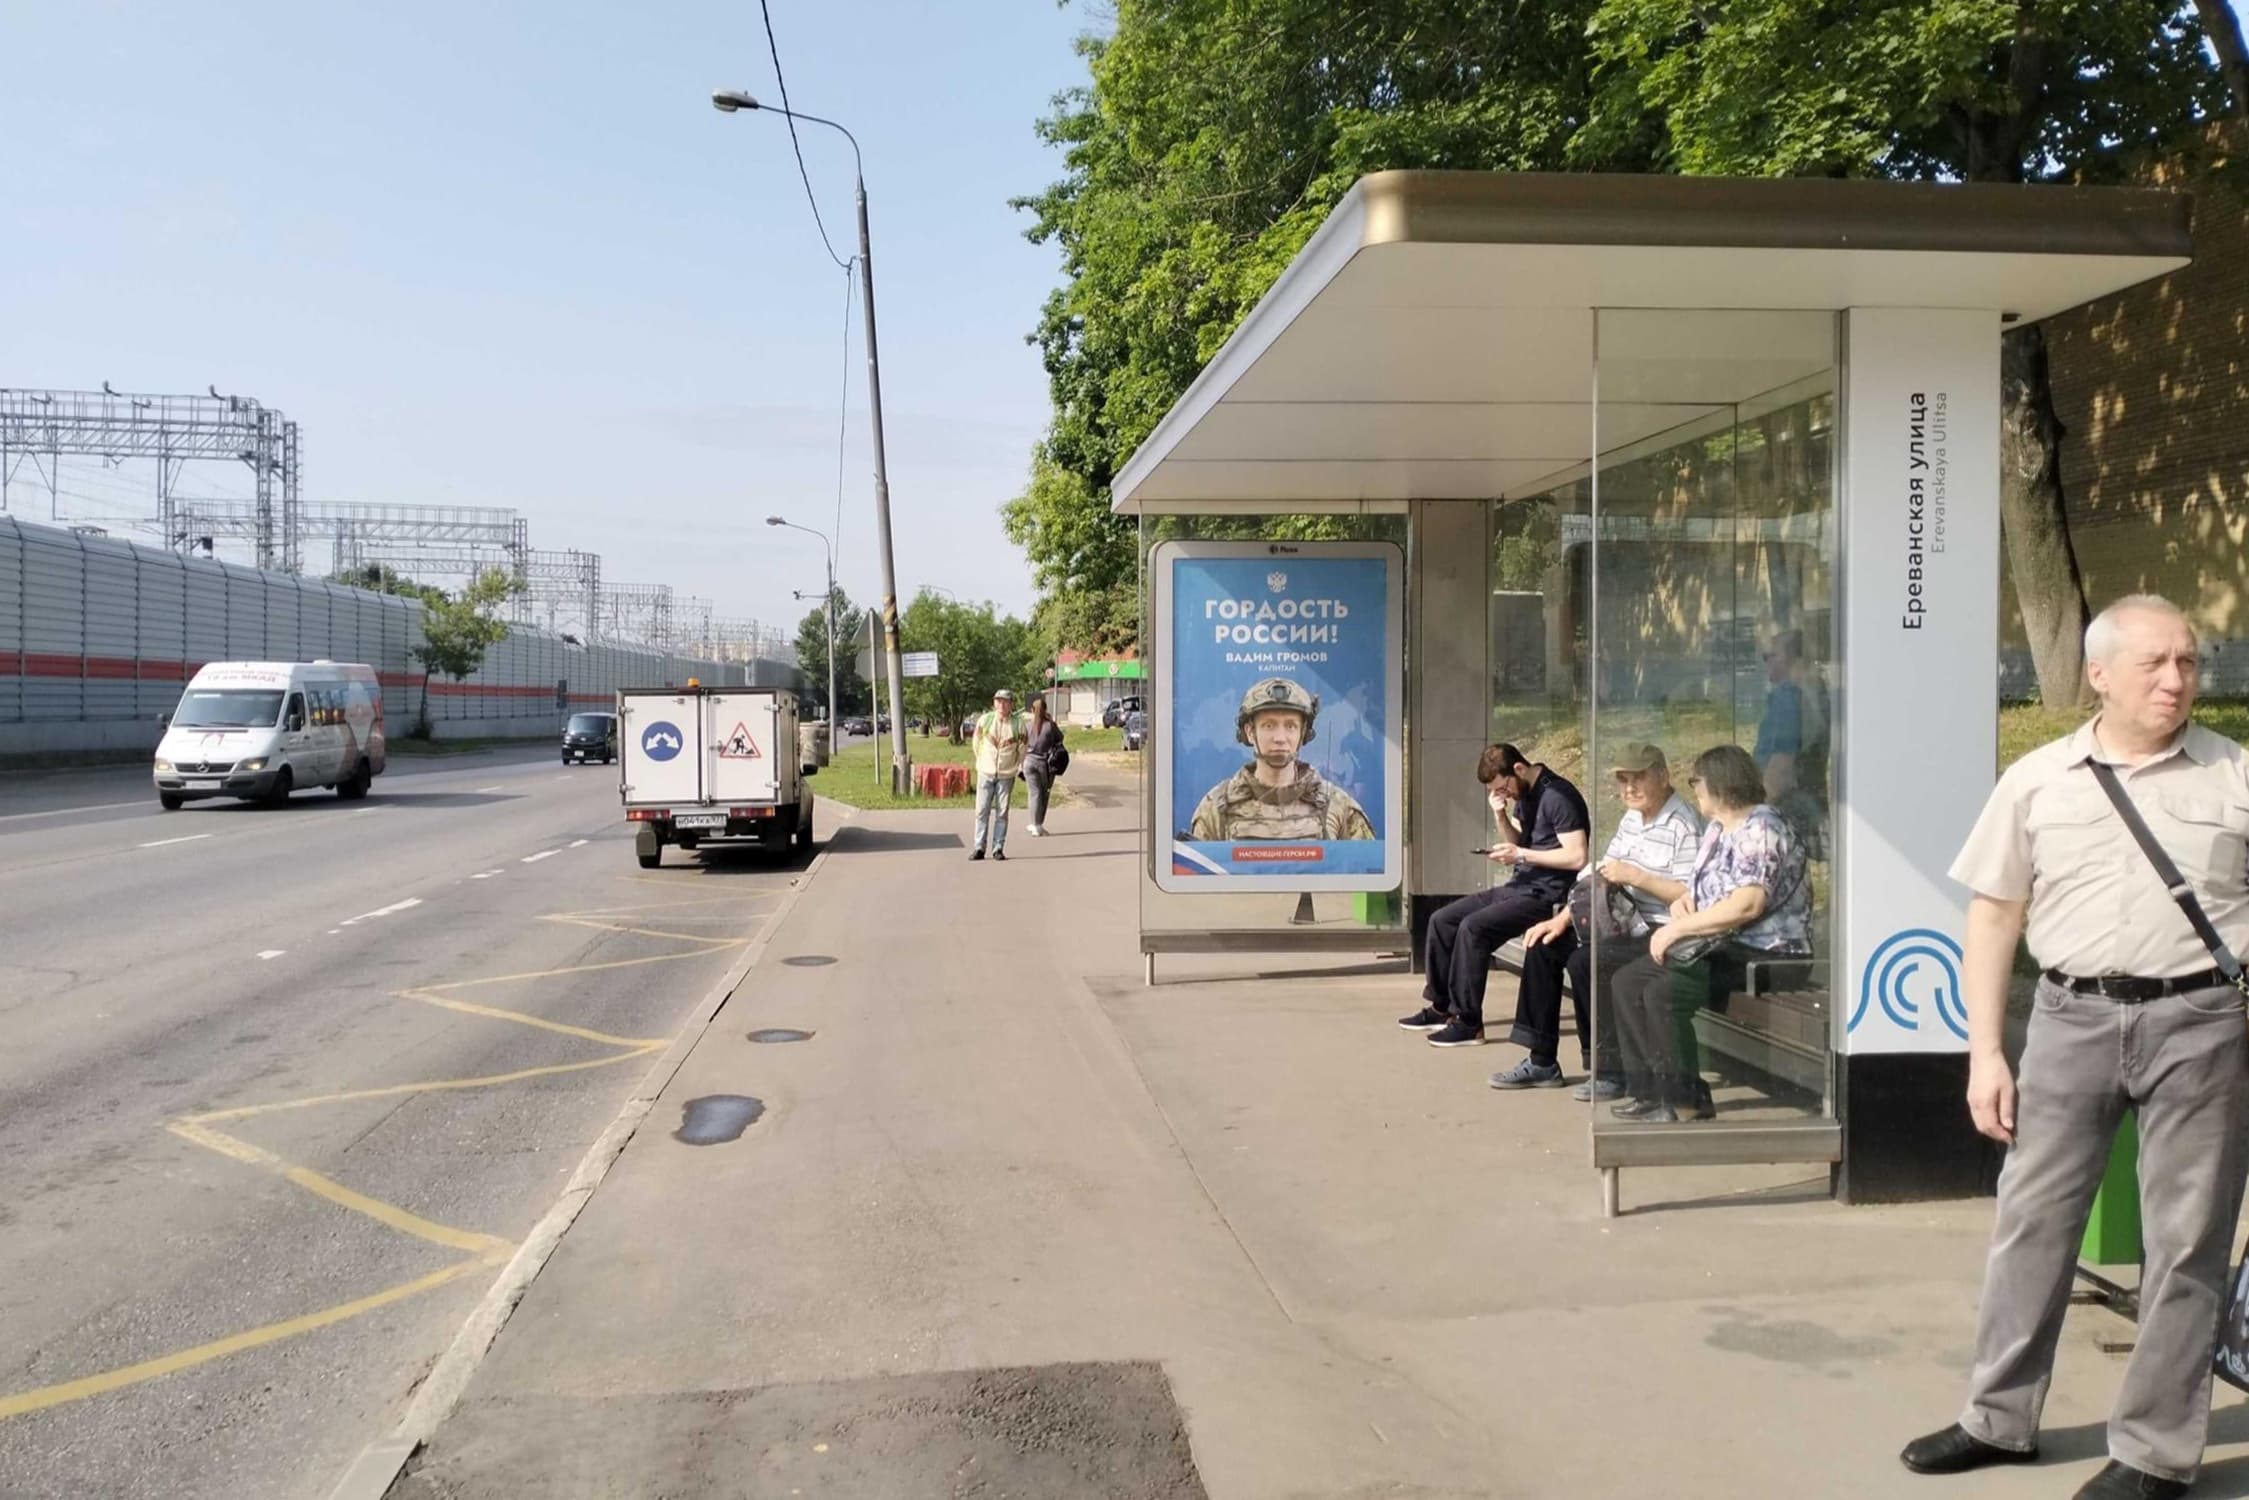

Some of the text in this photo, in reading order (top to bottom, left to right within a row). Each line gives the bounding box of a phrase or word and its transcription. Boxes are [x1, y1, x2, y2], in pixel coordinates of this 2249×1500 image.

[1930, 392, 1949, 554] Erevanskaya Ulitsa
[1902, 392, 1929, 630] Ереванская улица
[1205, 599, 1349, 621] ГОРДОСТЬ
[1215, 624, 1338, 644] РОССИИ!
[1225, 652, 1328, 663] ВАДИМ ГРОМОВ
[1258, 664, 1296, 672] КАПИТАН
